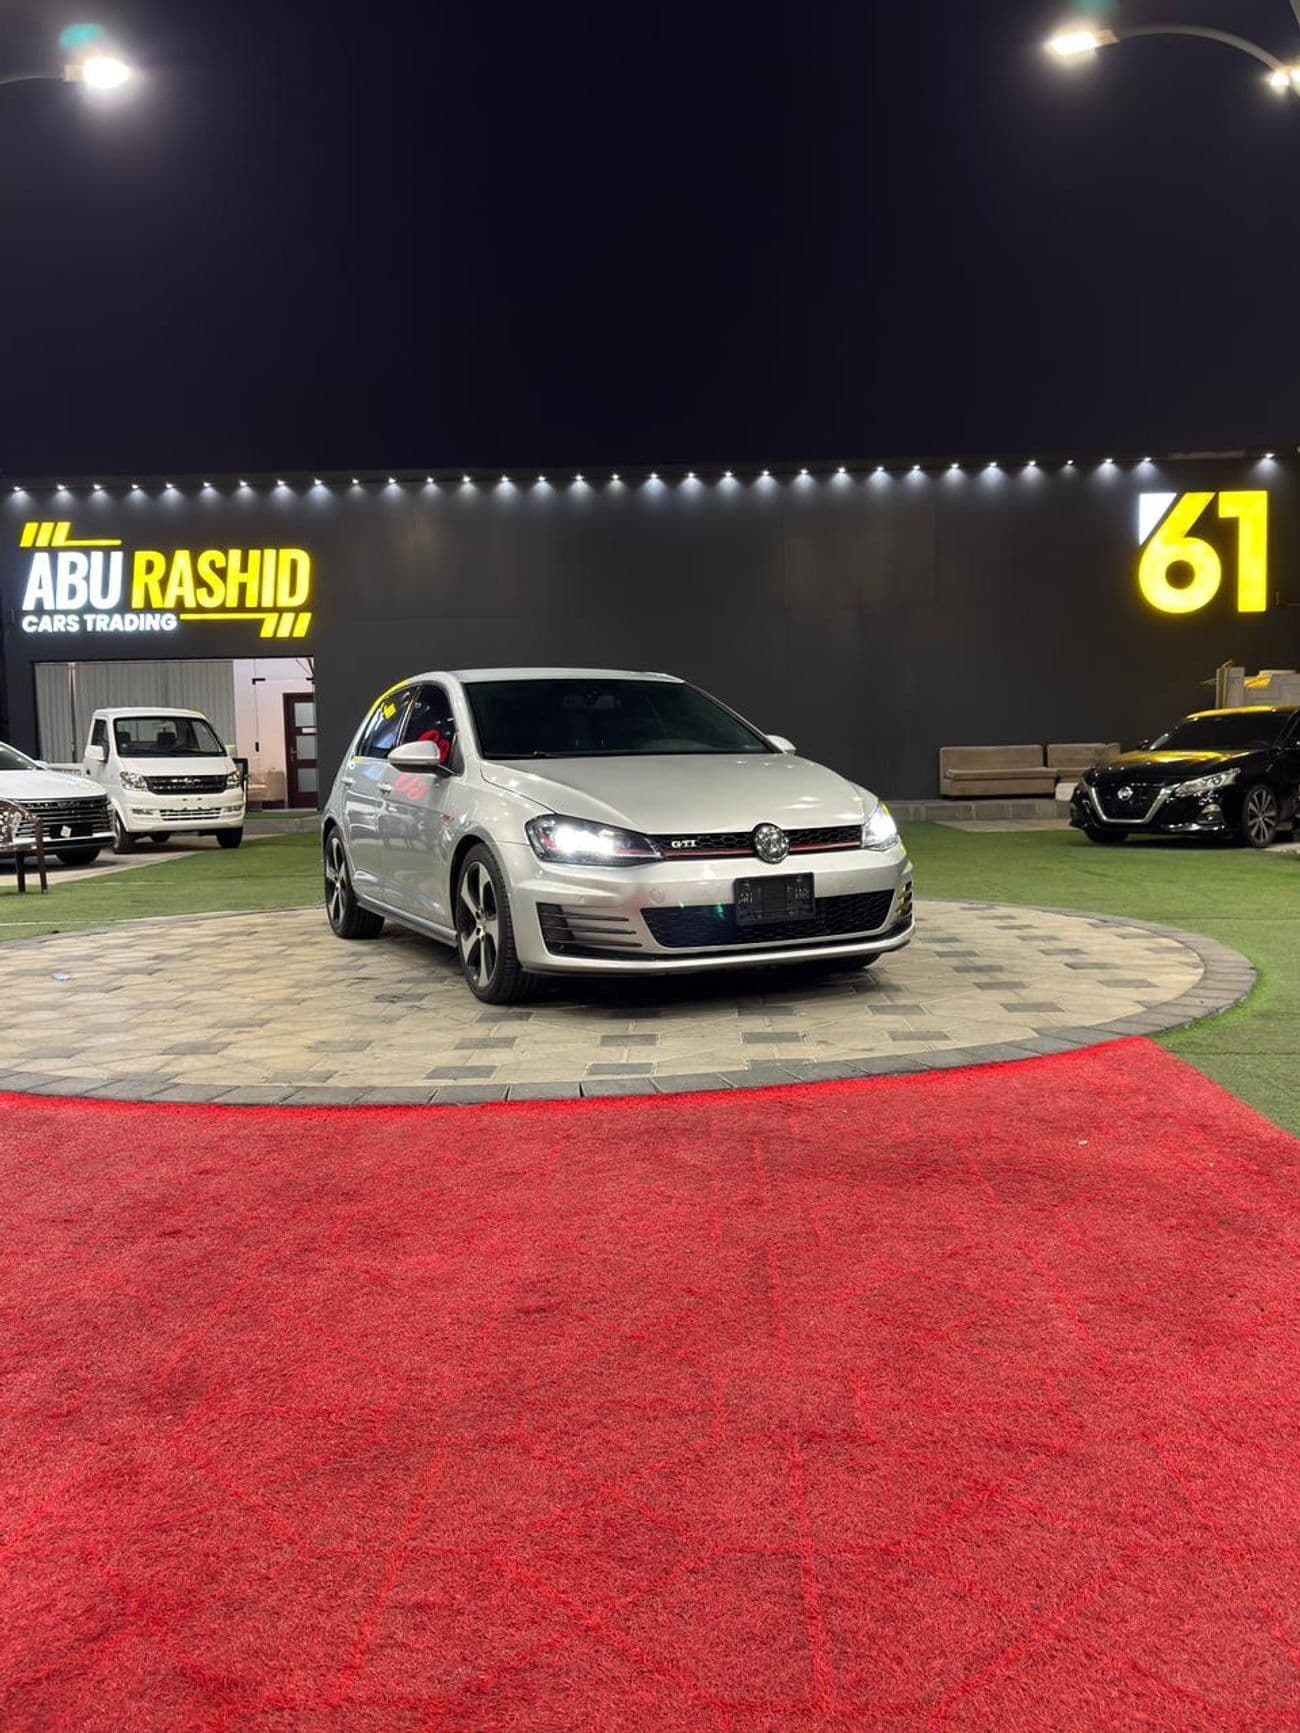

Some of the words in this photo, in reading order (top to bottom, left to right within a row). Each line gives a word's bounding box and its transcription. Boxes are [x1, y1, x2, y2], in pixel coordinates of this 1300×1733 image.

[1138, 490, 1268, 614] 61
[22, 551, 124, 611] ABU
[131, 548, 311, 608] RASHID
[21, 614, 80, 633] CARS
[83, 612, 178, 632] TRADING
[671, 839, 697, 849] GTI
